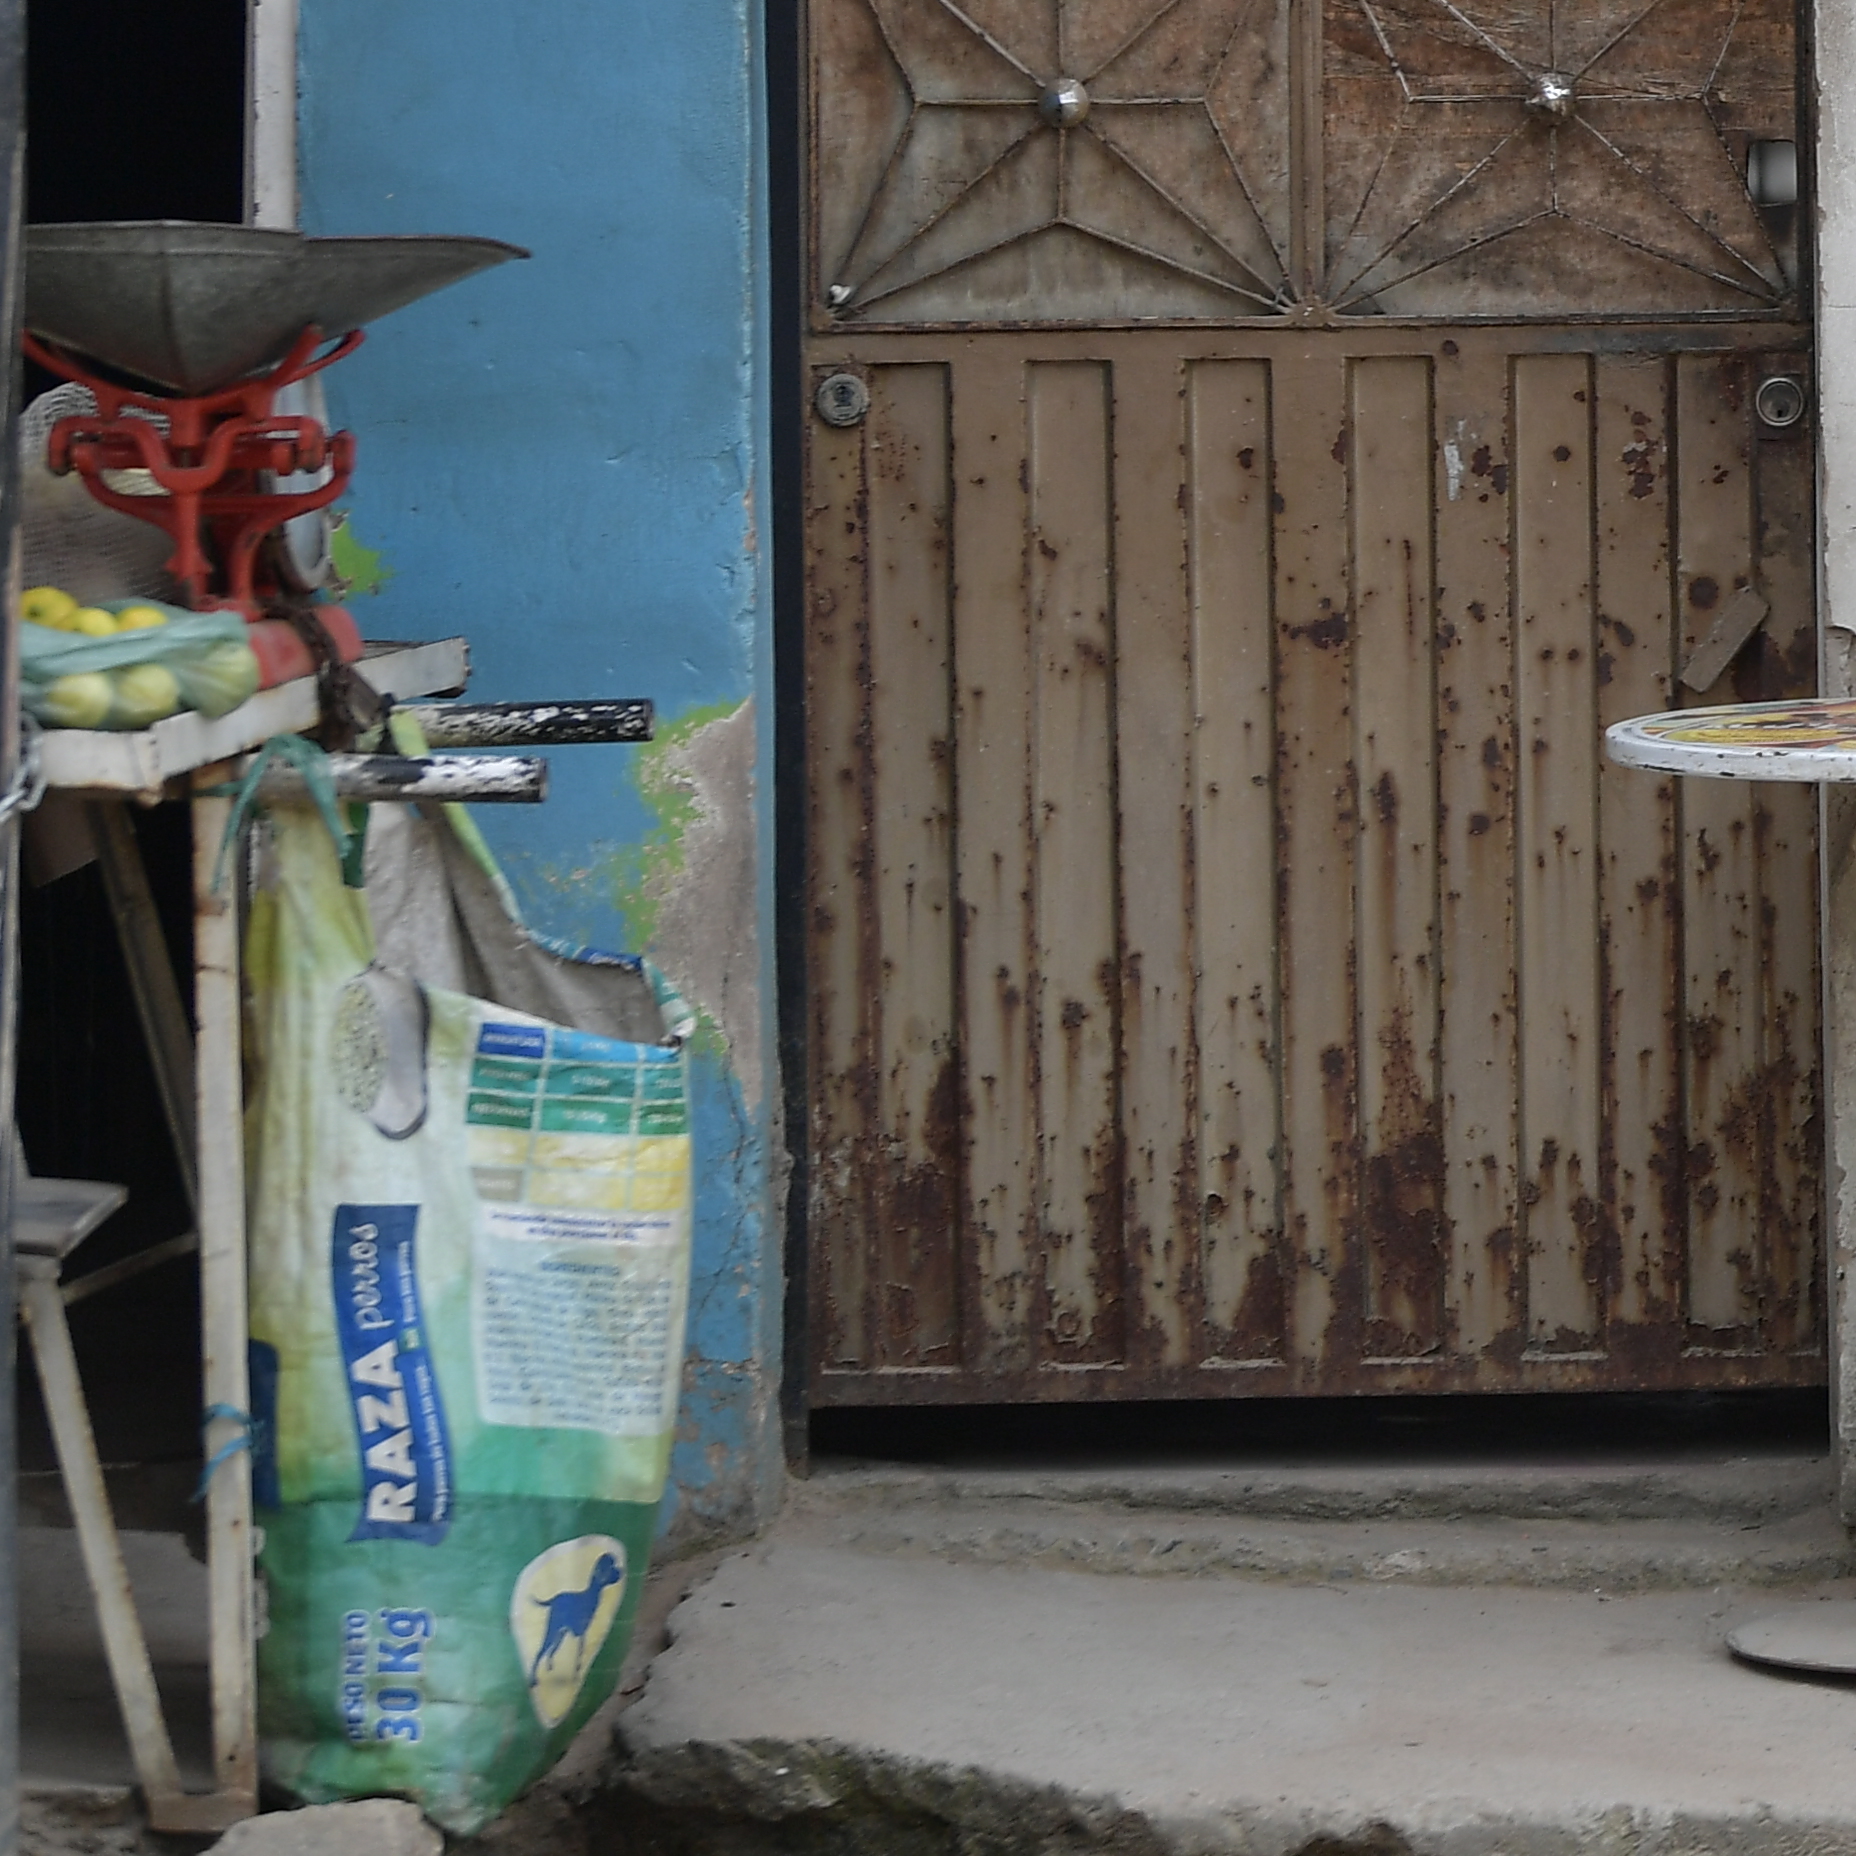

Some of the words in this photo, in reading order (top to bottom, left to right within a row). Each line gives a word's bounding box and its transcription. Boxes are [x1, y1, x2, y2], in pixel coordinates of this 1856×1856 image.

[348, 1221, 396, 1331] perros
[350, 1338, 418, 1524] RAZA
[377, 1608, 431, 1674] Kg
[376, 1687, 420, 1742] 30
